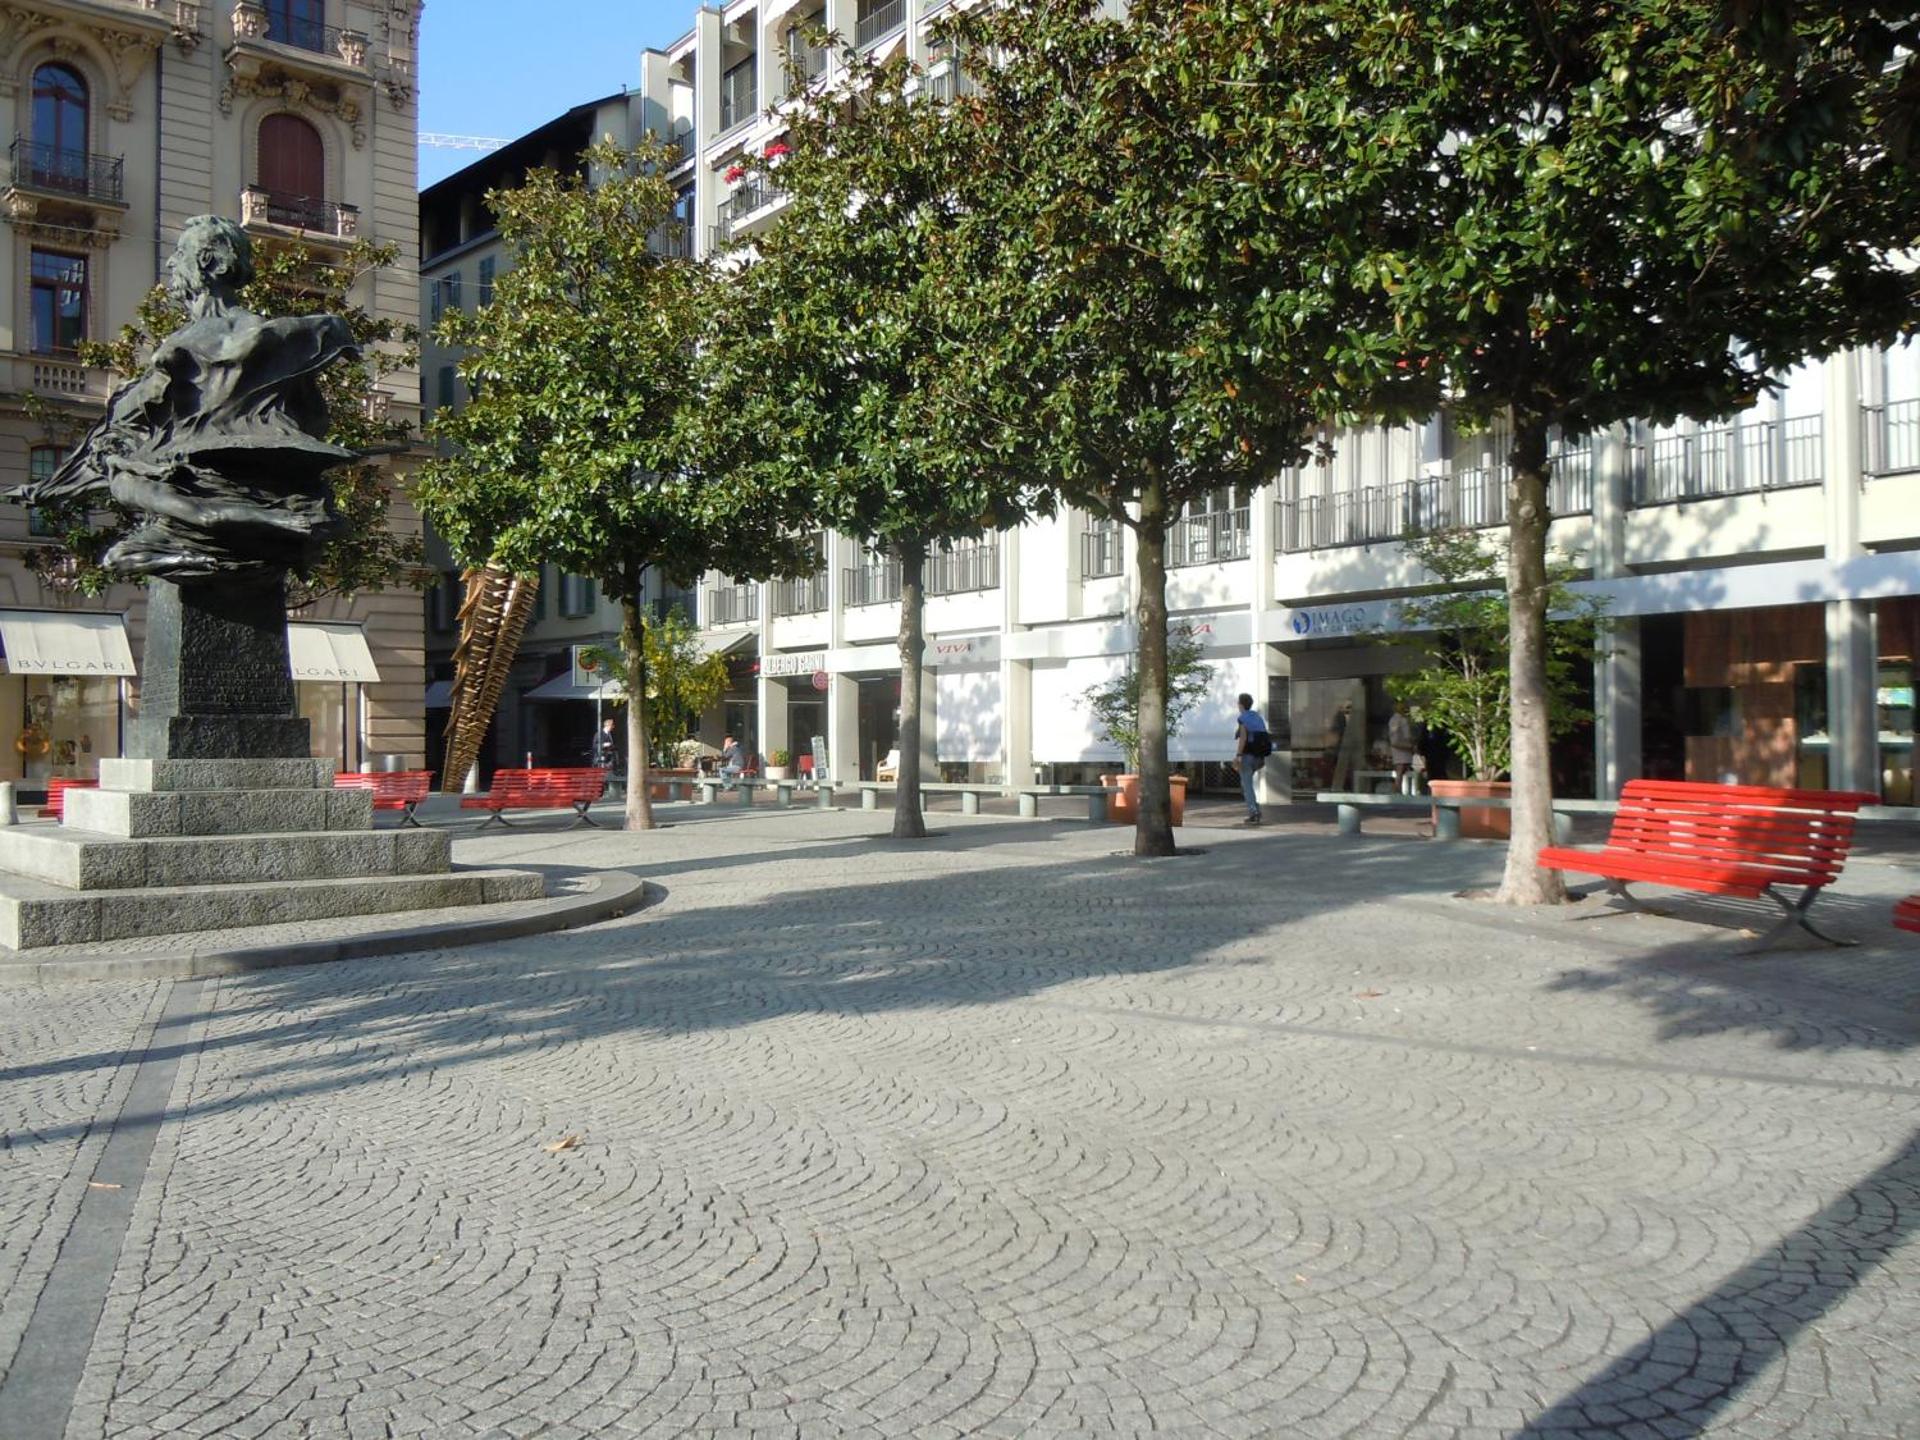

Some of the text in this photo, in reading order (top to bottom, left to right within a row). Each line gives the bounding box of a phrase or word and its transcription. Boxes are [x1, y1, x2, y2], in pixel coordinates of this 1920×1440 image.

[1312, 607, 1366, 625] IMAGO
[18, 660, 126, 670] BVLGARI
[295, 667, 360, 677] LGARI
